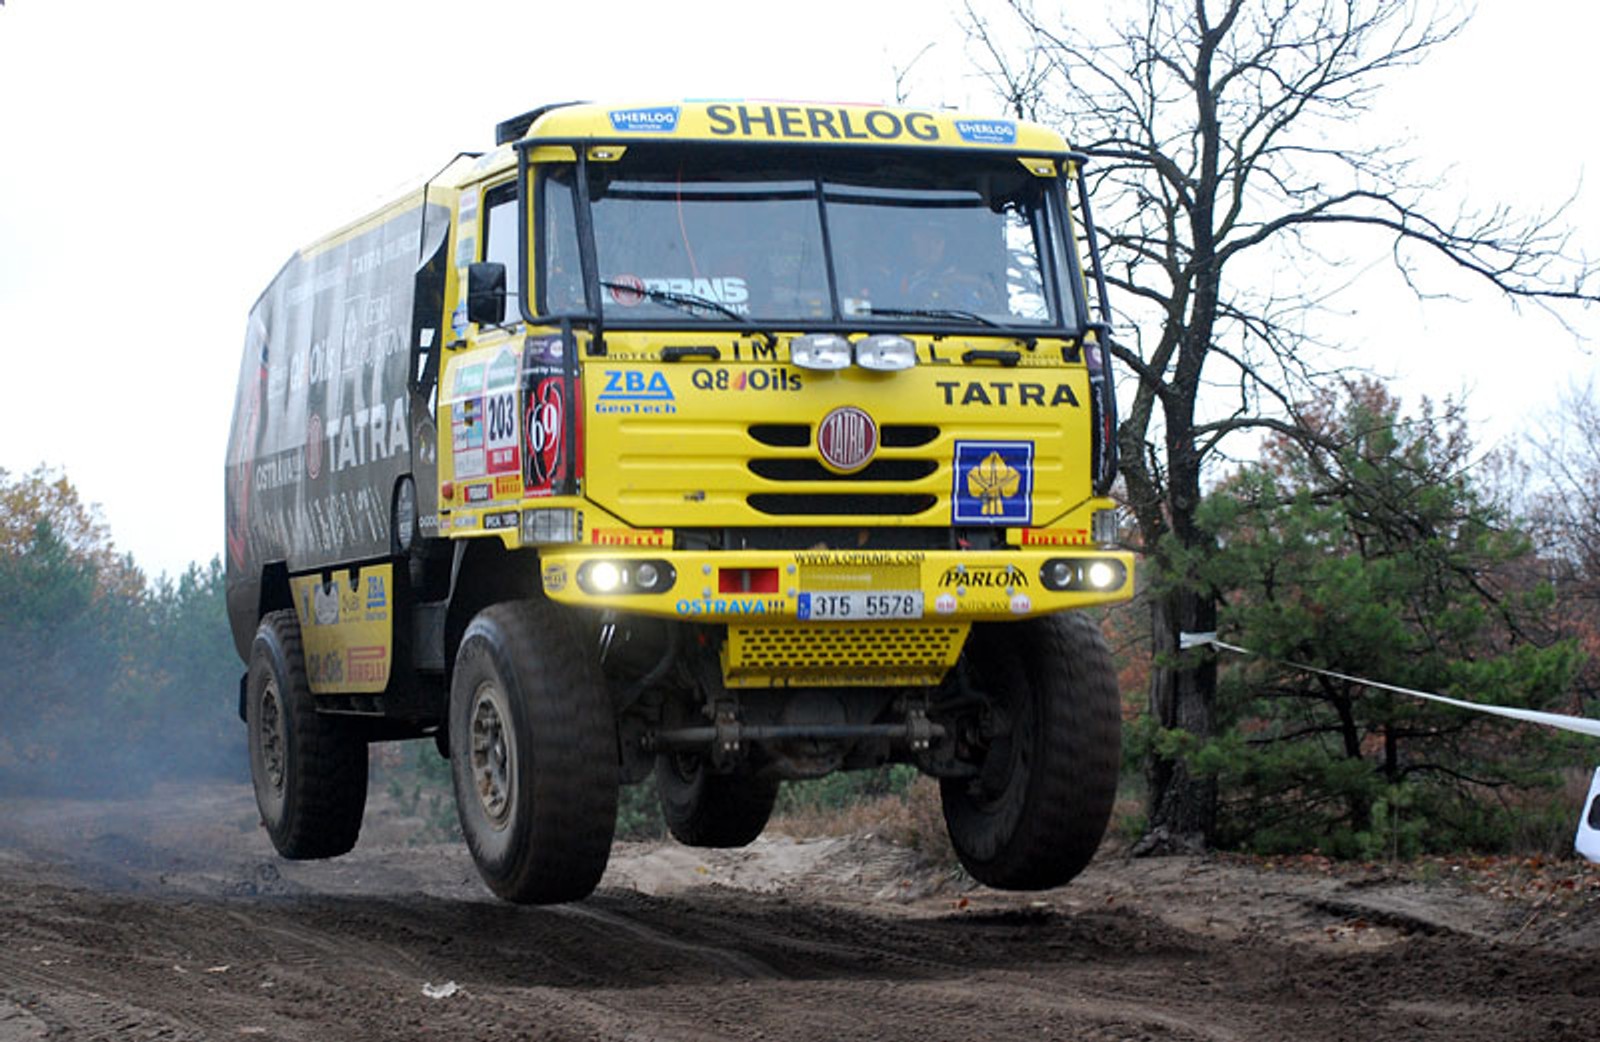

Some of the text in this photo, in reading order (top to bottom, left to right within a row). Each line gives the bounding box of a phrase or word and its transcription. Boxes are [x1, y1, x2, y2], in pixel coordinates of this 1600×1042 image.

[613, 111, 675, 123] SHERLOG
[706, 104, 940, 141] SHERLOG
[958, 122, 1014, 136] SHERLOG
[603, 371, 672, 394] ZBA
[691, 368, 802, 391] Q8 Oils
[936, 381, 1080, 408] TATRA
[488, 393, 514, 441] 203
[594, 403, 677, 413] GeoTech
[326, 393, 410, 473] TATRA
[829, 411, 867, 465] TATRA
[866, 595, 914, 616] 5578
